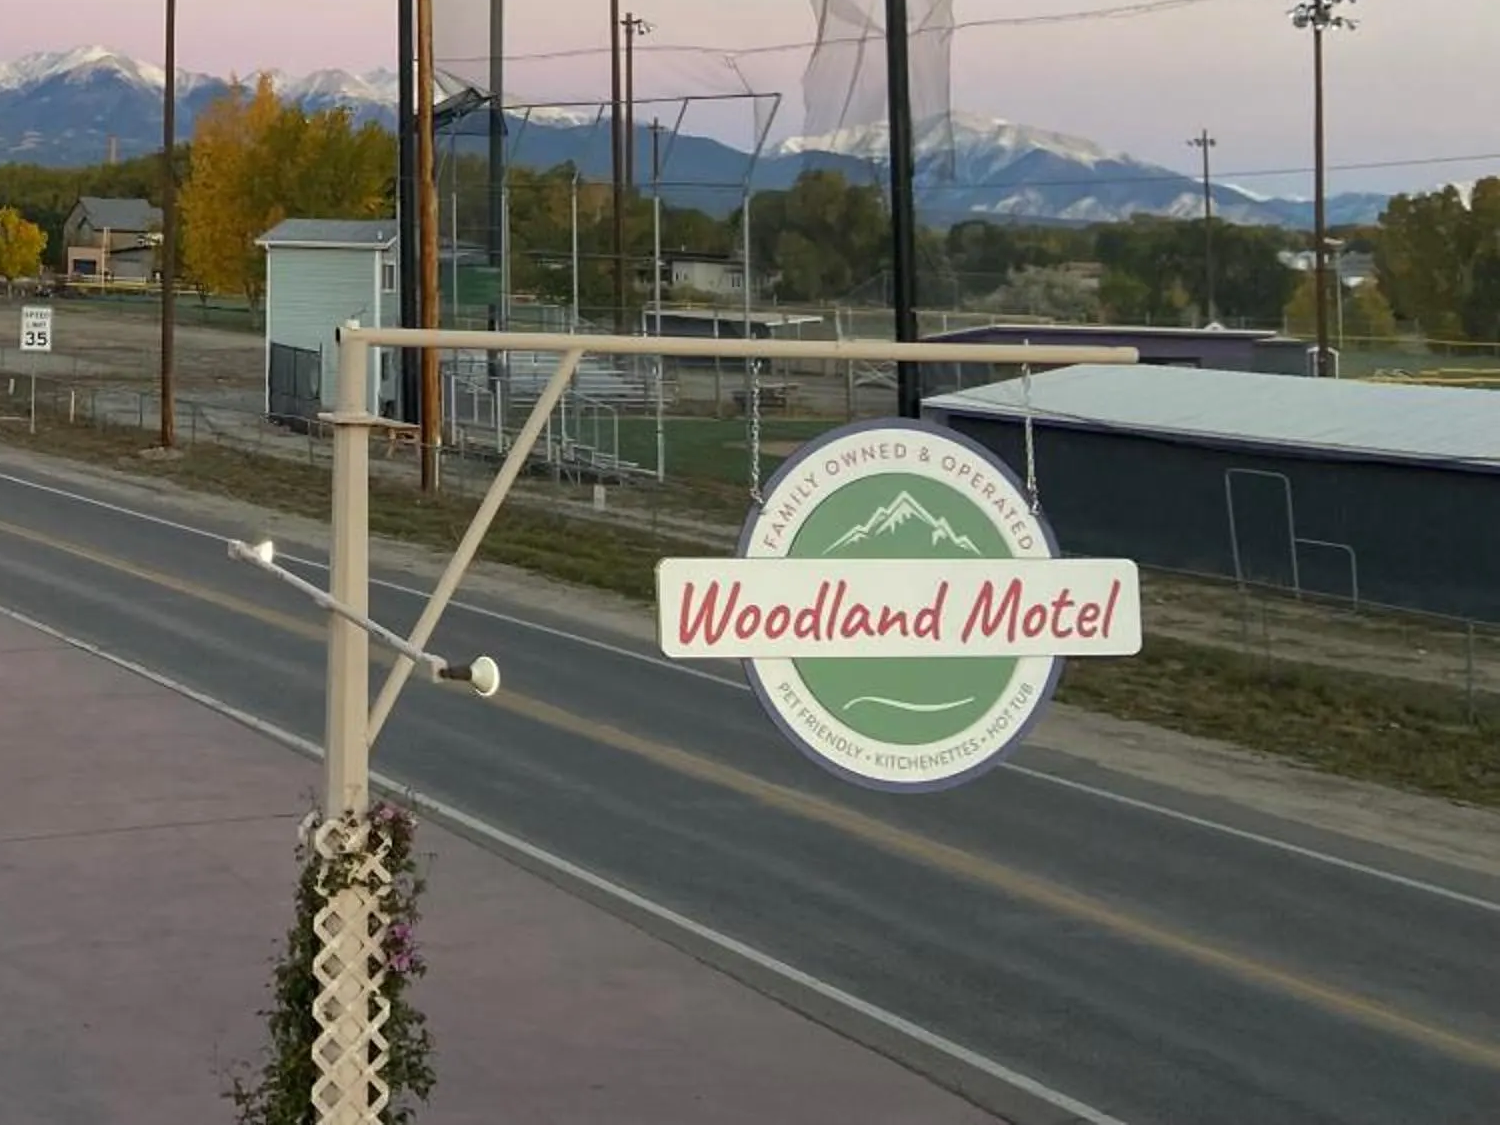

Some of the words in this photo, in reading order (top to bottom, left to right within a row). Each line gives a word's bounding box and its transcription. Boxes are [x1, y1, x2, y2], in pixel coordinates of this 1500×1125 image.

[25, 331, 47, 346] 35
[763, 473, 819, 550] FAMILY
[825, 442, 907, 476] OWNED
[919, 446, 930, 462] &
[942, 456, 1034, 550] OPERATED
[678, 579, 949, 645] Woodland
[960, 578, 1122, 644] Motel
[778, 682, 801, 709] PET
[799, 707, 864, 758] FRIENDLY
[875, 738, 980, 770] KITCHENETTES
[986, 709, 1013, 740] HOT
[1010, 682, 1034, 711] TUB
